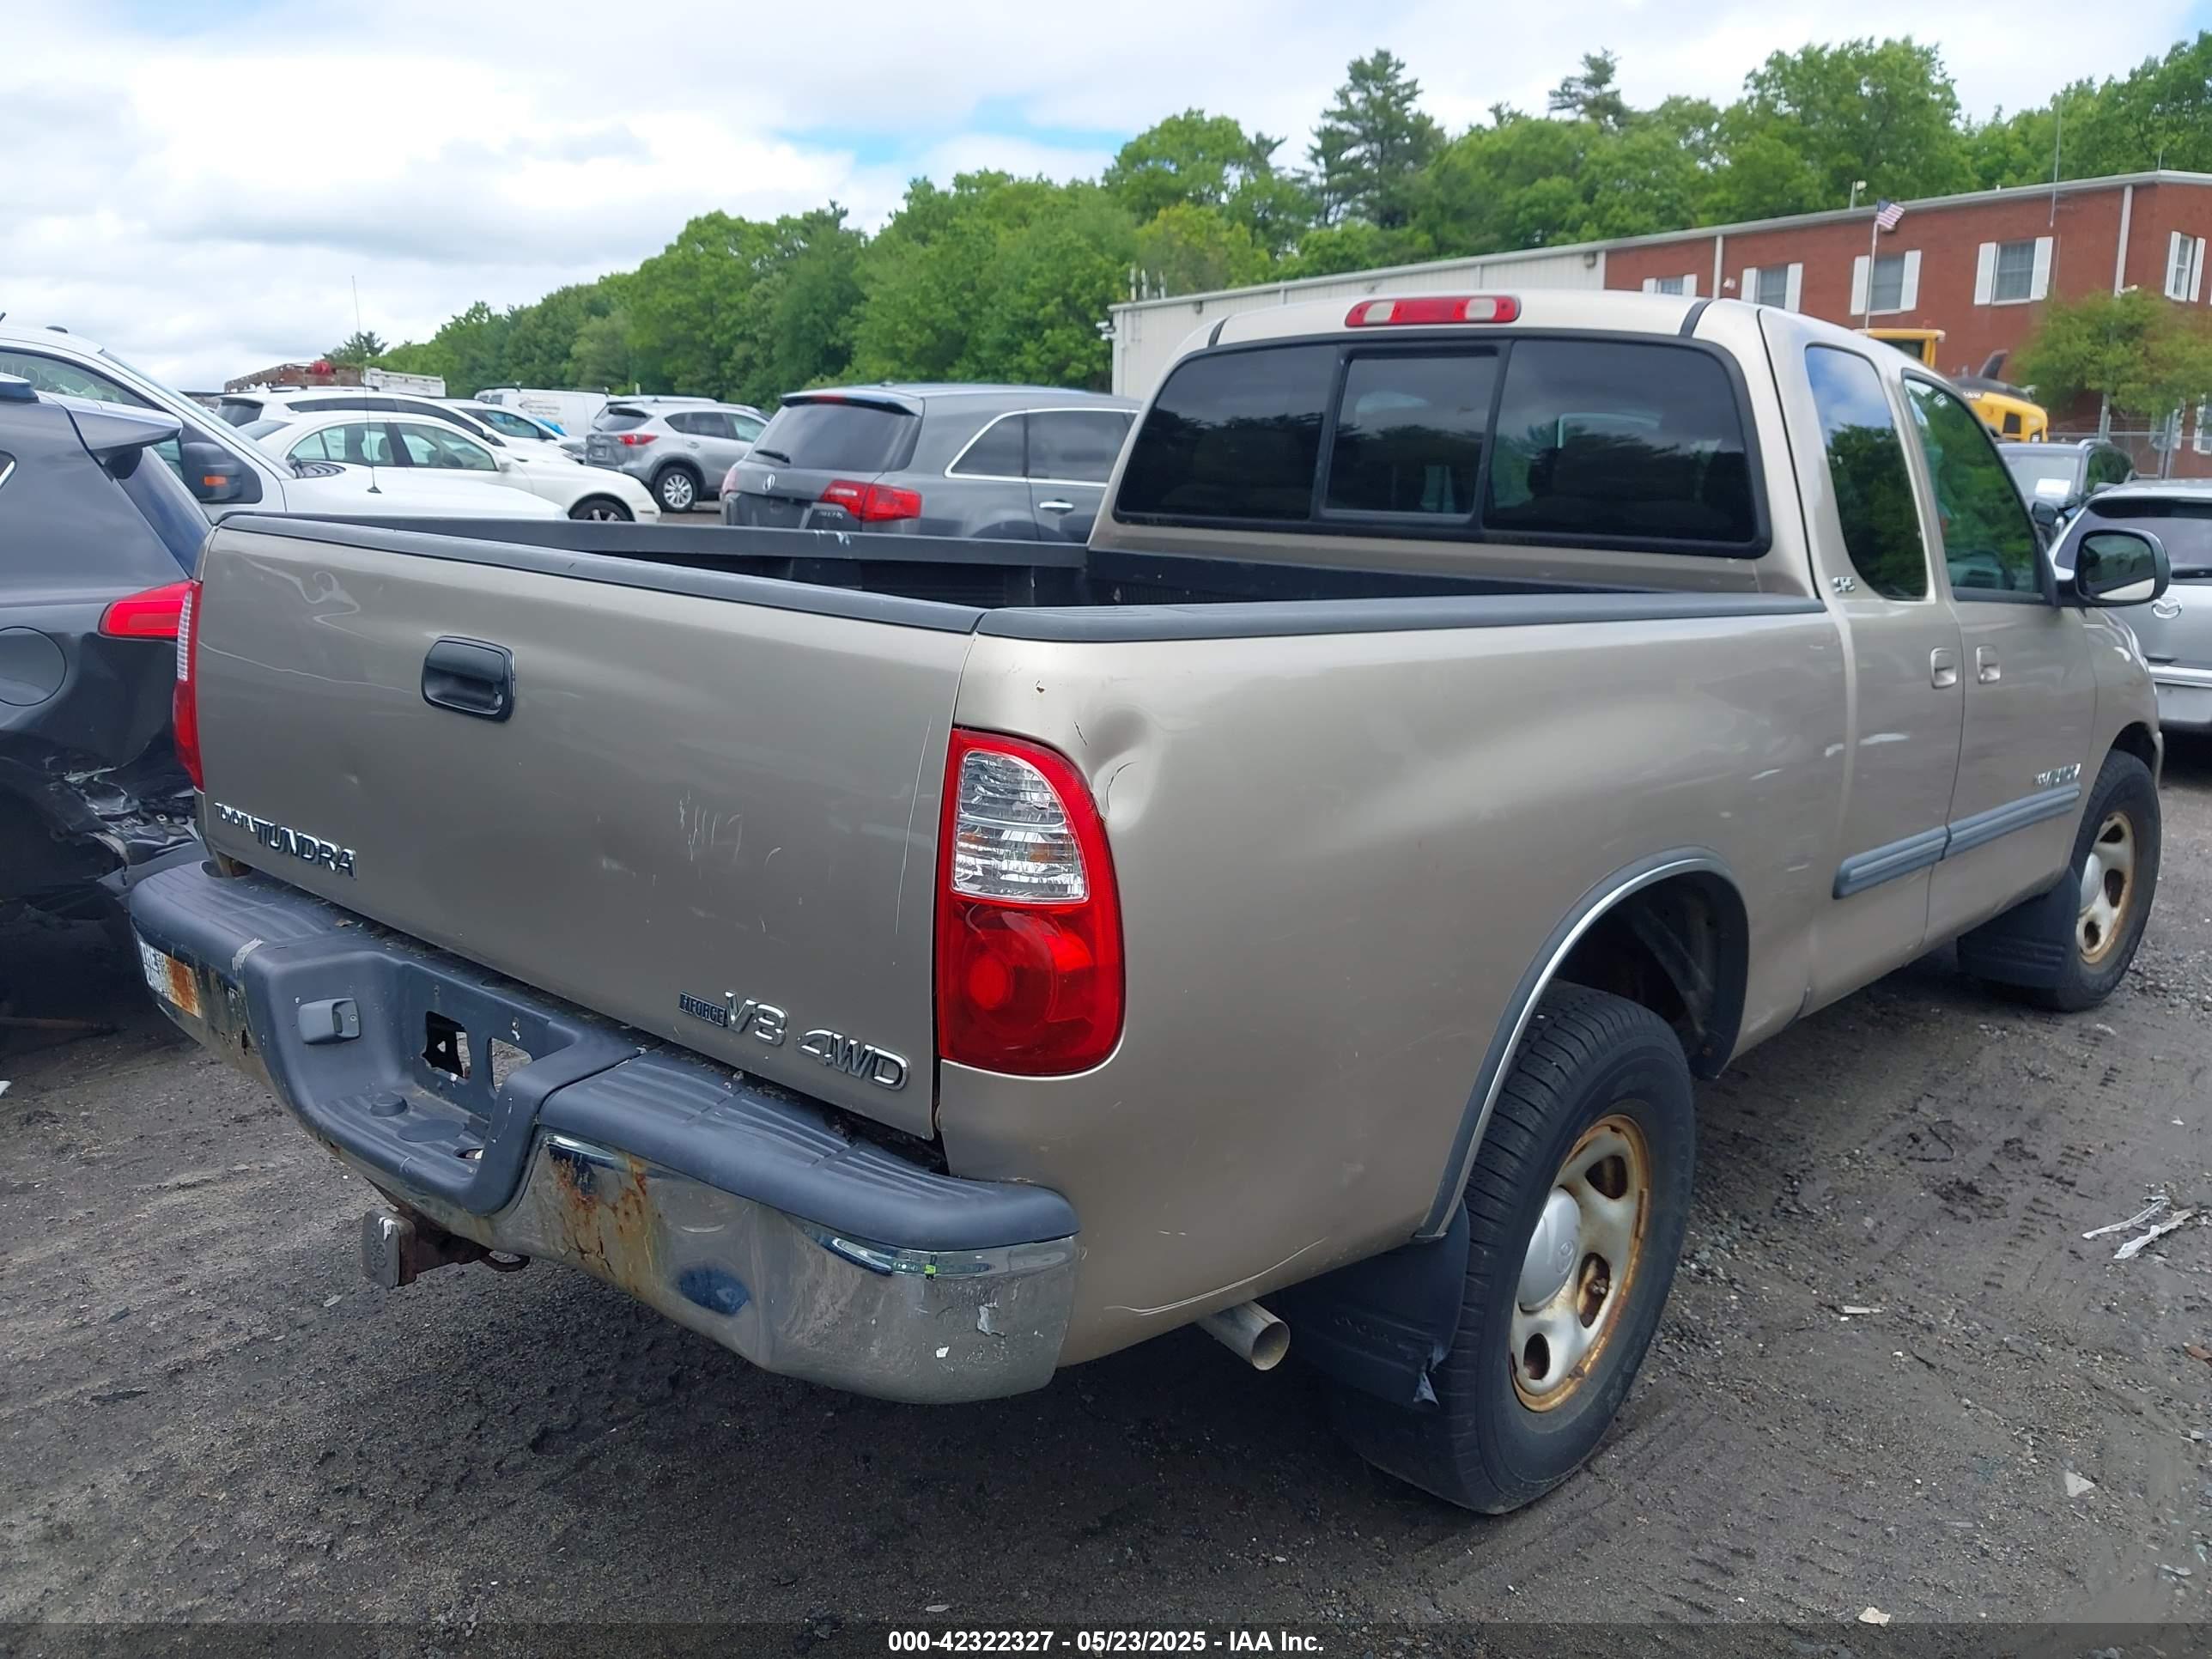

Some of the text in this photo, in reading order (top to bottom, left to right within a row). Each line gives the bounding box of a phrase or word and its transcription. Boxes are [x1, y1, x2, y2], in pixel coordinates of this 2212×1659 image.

[214, 801, 358, 880] TOYOTA TUNDRA
[725, 990, 787, 1047] V8
[796, 1028, 910, 1091] 4WD
